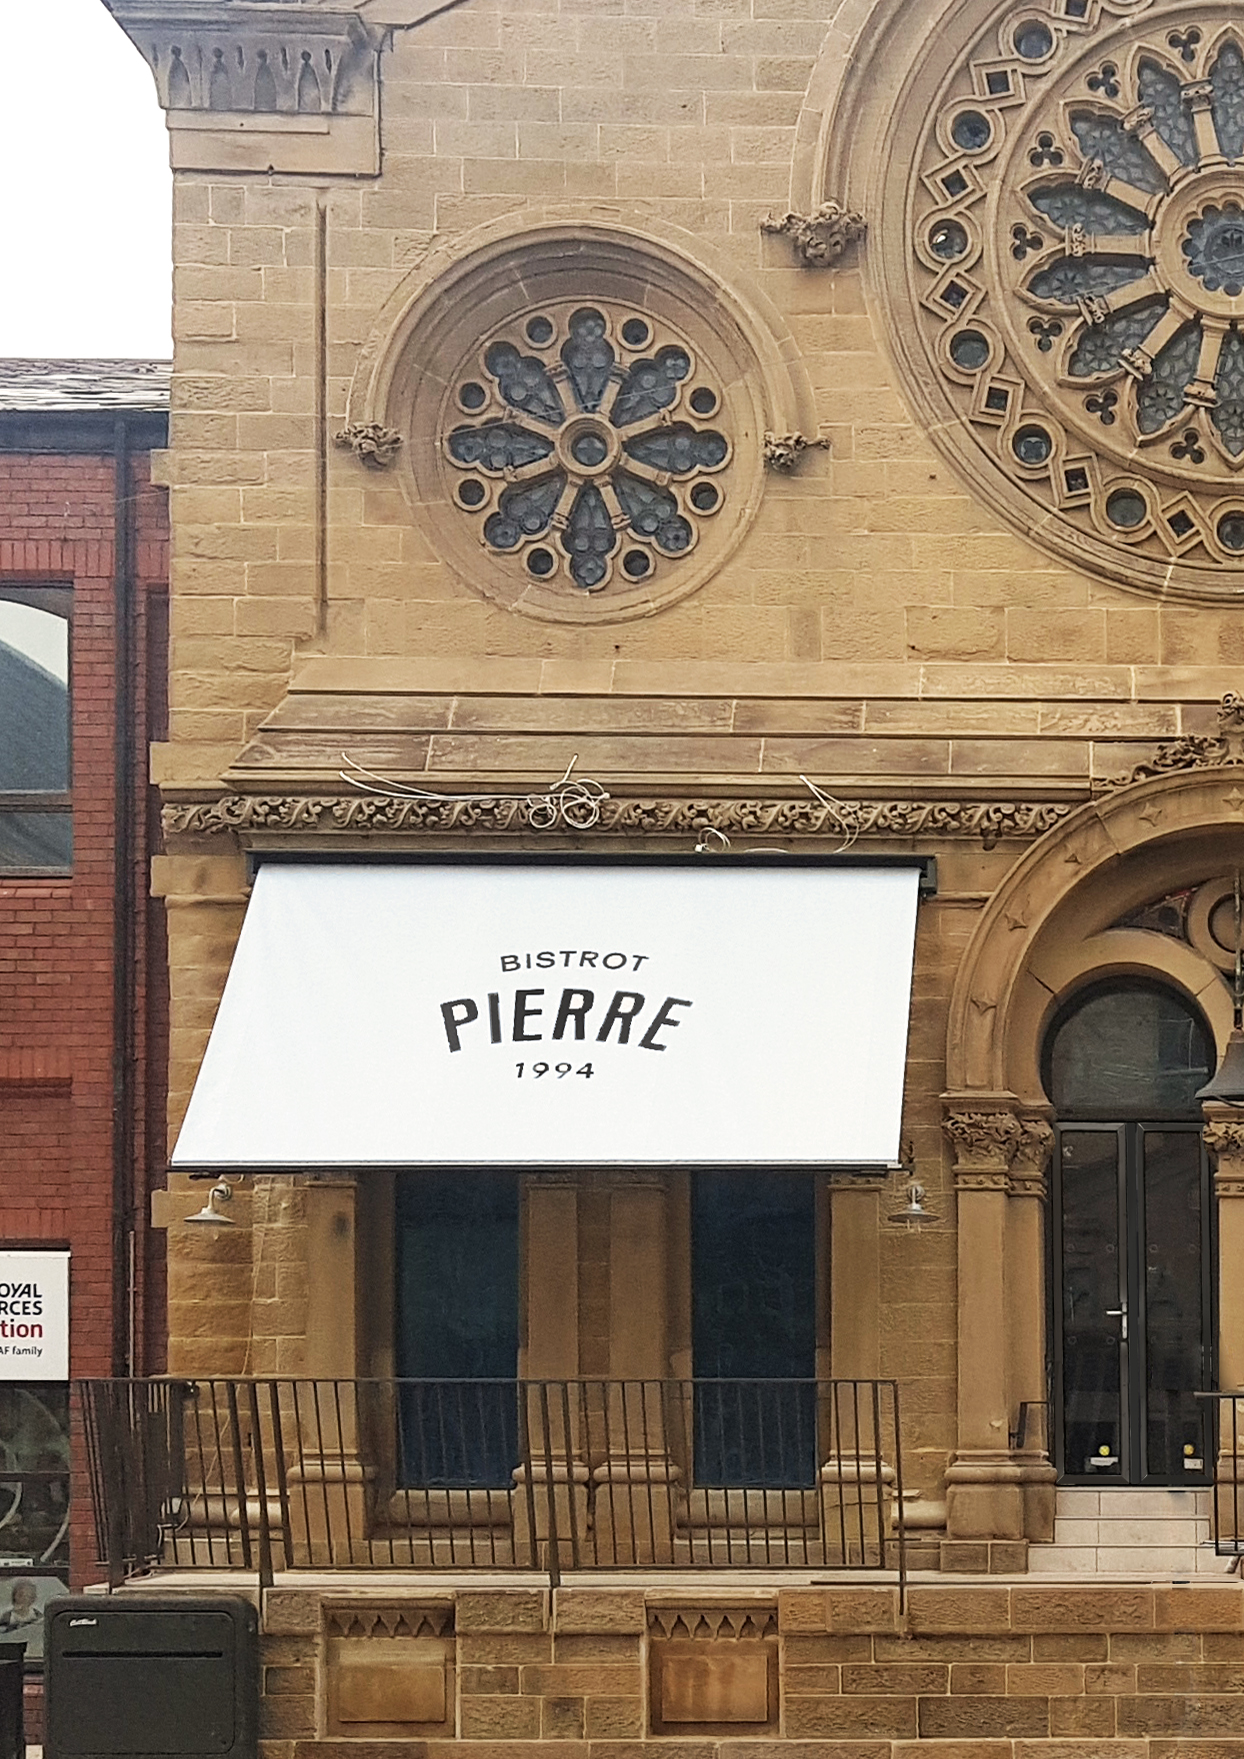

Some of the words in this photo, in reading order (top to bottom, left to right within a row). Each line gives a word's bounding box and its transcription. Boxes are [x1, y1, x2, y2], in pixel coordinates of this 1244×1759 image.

[500, 950, 650, 973] BISTROT
[439, 988, 694, 1053] PIERRE
[515, 1061, 595, 1079] 1994
[0, 1318, 43, 1338] tion
[12, 1345, 43, 1357] family
